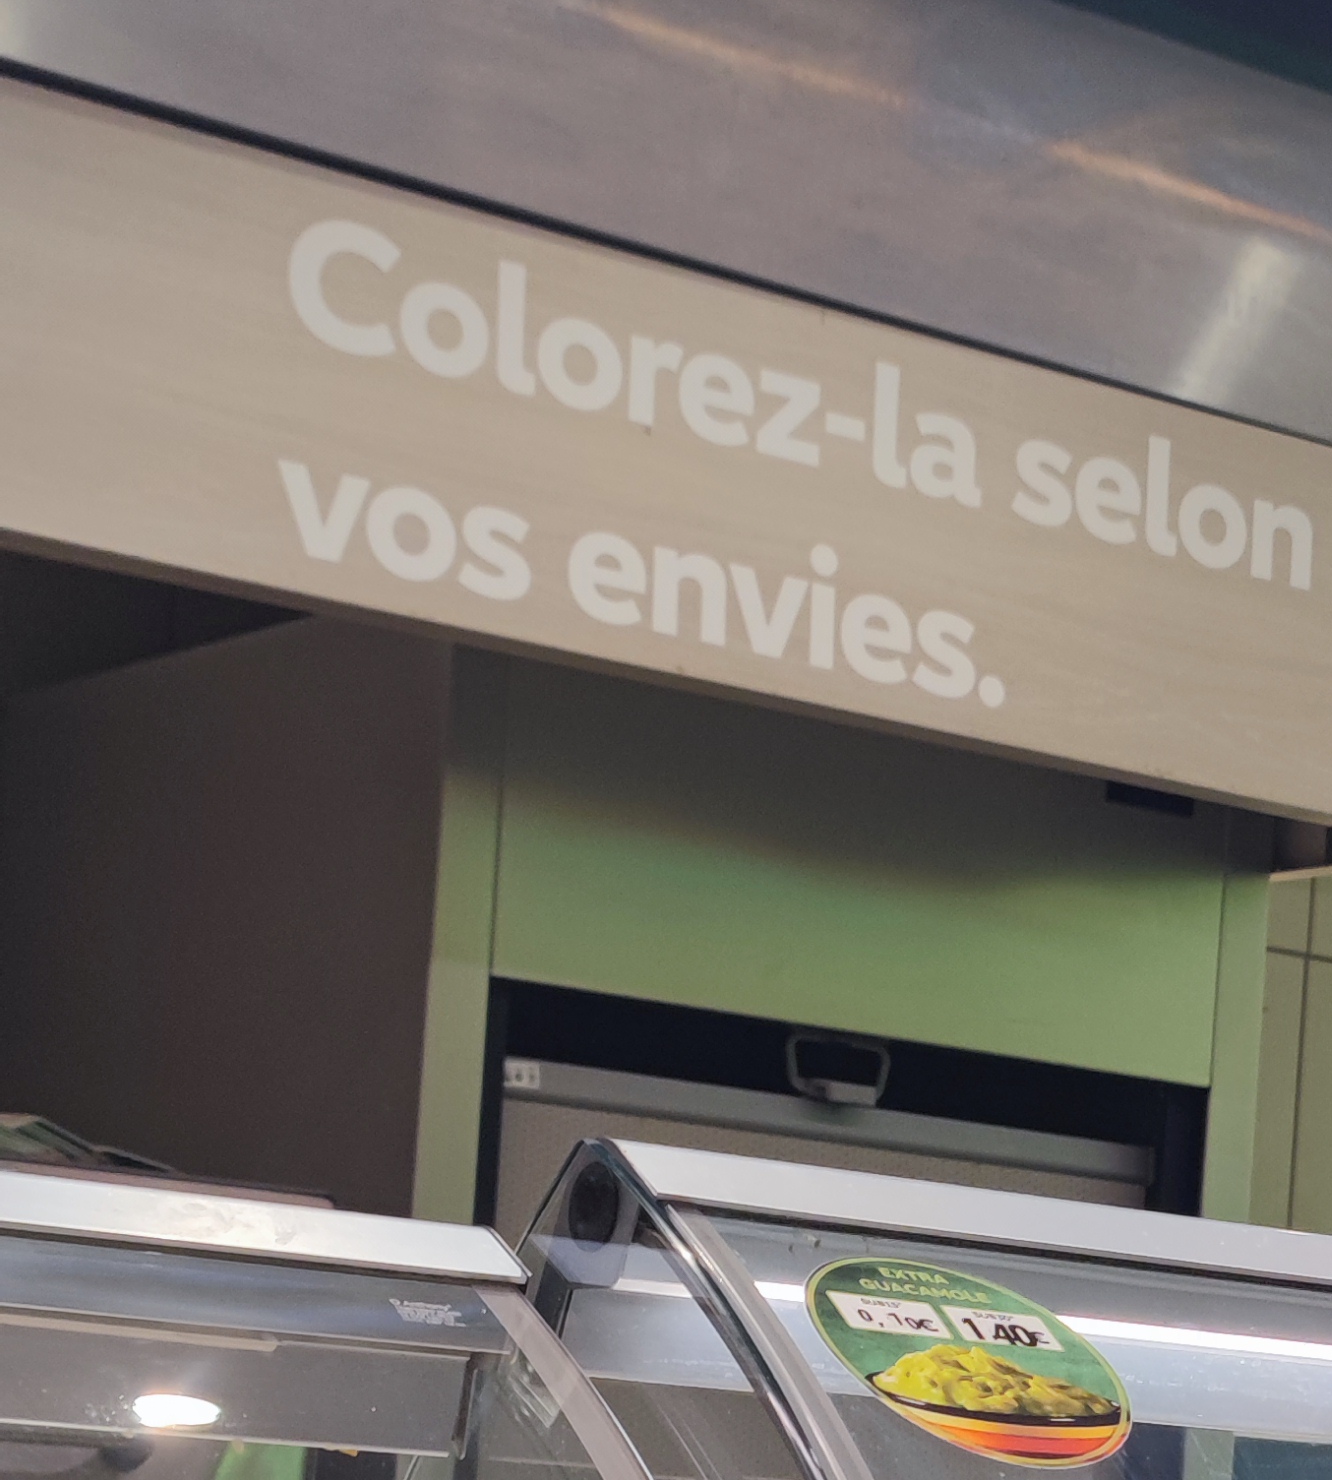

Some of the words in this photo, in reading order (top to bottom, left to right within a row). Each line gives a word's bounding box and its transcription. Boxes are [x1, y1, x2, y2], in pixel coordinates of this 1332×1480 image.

[286, 219, 983, 507] Colorez-la
[1011, 436, 1316, 591] selon
[277, 458, 535, 601] vos
[567, 542, 1006, 708] envies.
[859, 1278, 992, 1304] GUACAMOLE
[878, 1267, 949, 1285] EXTRA
